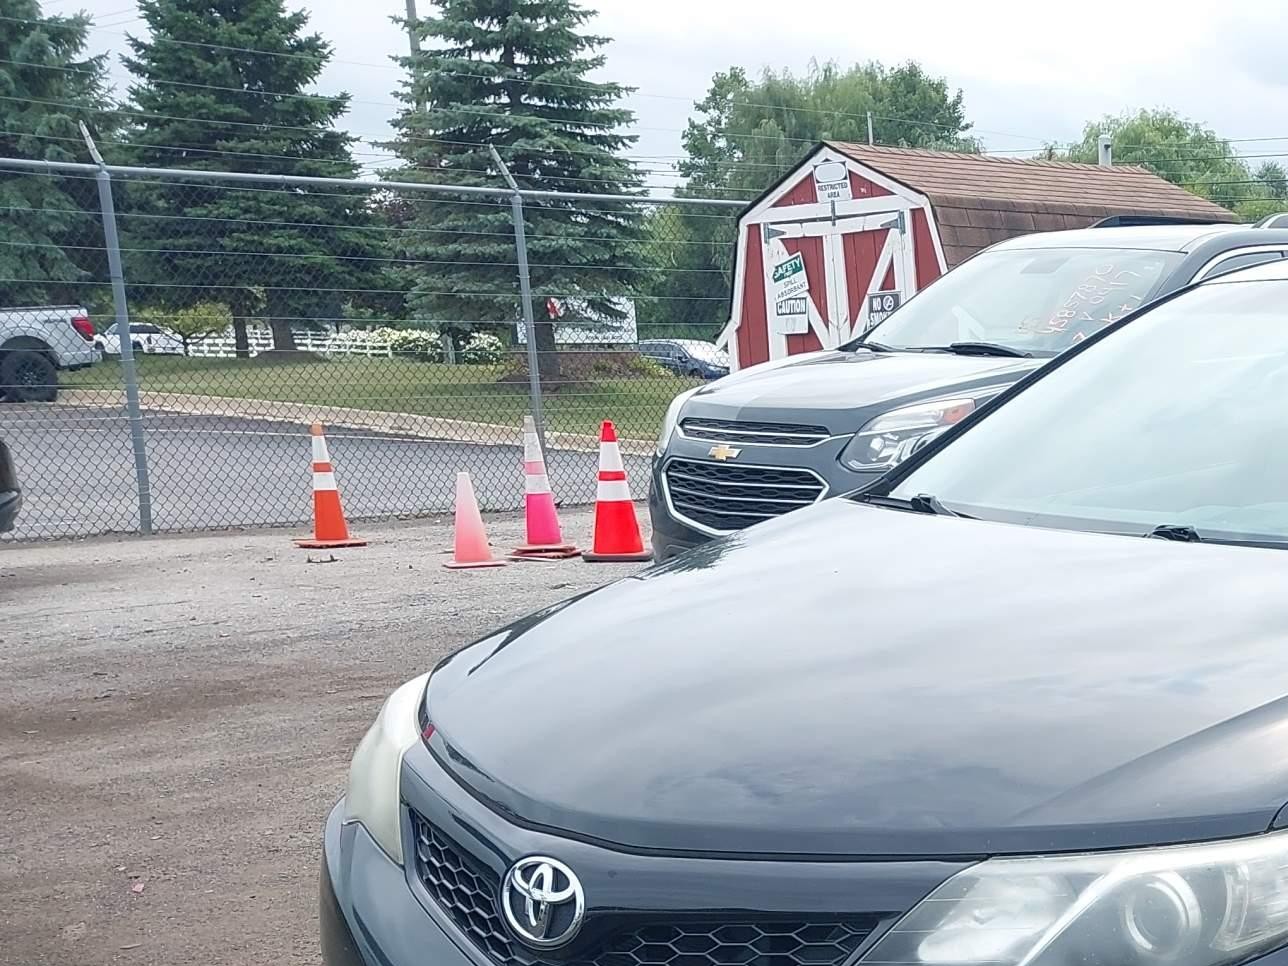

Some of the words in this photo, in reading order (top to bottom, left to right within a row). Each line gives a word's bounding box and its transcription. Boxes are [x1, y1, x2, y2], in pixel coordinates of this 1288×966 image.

[817, 182, 848, 191] RESTRICTED
[774, 257, 801, 279] SAFETY
[777, 298, 806, 314] CAUTION
[872, 296, 882, 311] NO
